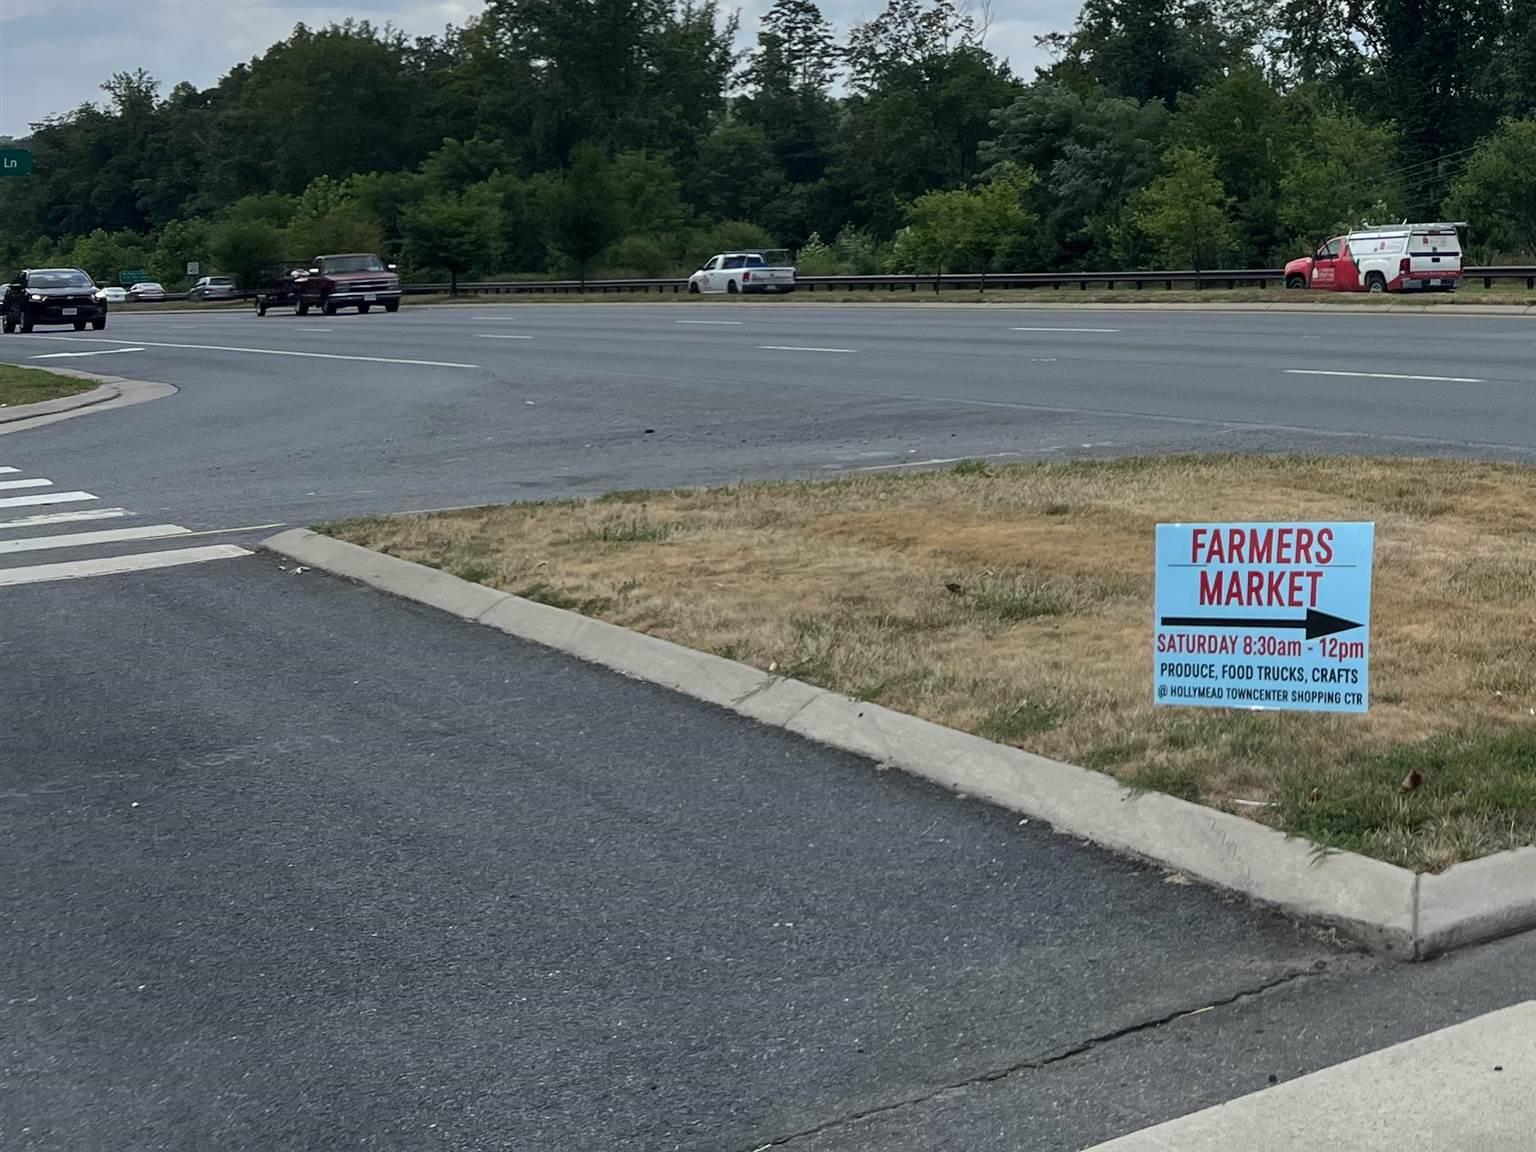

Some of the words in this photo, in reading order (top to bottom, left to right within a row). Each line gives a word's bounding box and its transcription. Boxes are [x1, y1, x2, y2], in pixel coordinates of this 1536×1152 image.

[3, 157, 17, 168] Ln
[1191, 528, 1334, 564] FARMERS
[1199, 570, 1323, 607] MARKET
[1157, 633, 1238, 655] SATURDAY
[1243, 635, 1302, 657] 8:30am
[1319, 637, 1364, 662] 12pm
[1160, 662, 1218, 680] PRODUCE,
[1222, 664, 1254, 680] FOOD
[1257, 666, 1308, 684] TRUCKS,
[1312, 667, 1358, 684] CRAFTS
[1158, 684, 1168, 698] @
[1170, 685, 1224, 699] HOLLYMEAD
[1226, 687, 1288, 701] TOWNCENTER
[1291, 690, 1341, 704] SHOPPING
[1344, 692, 1363, 705] CTR
